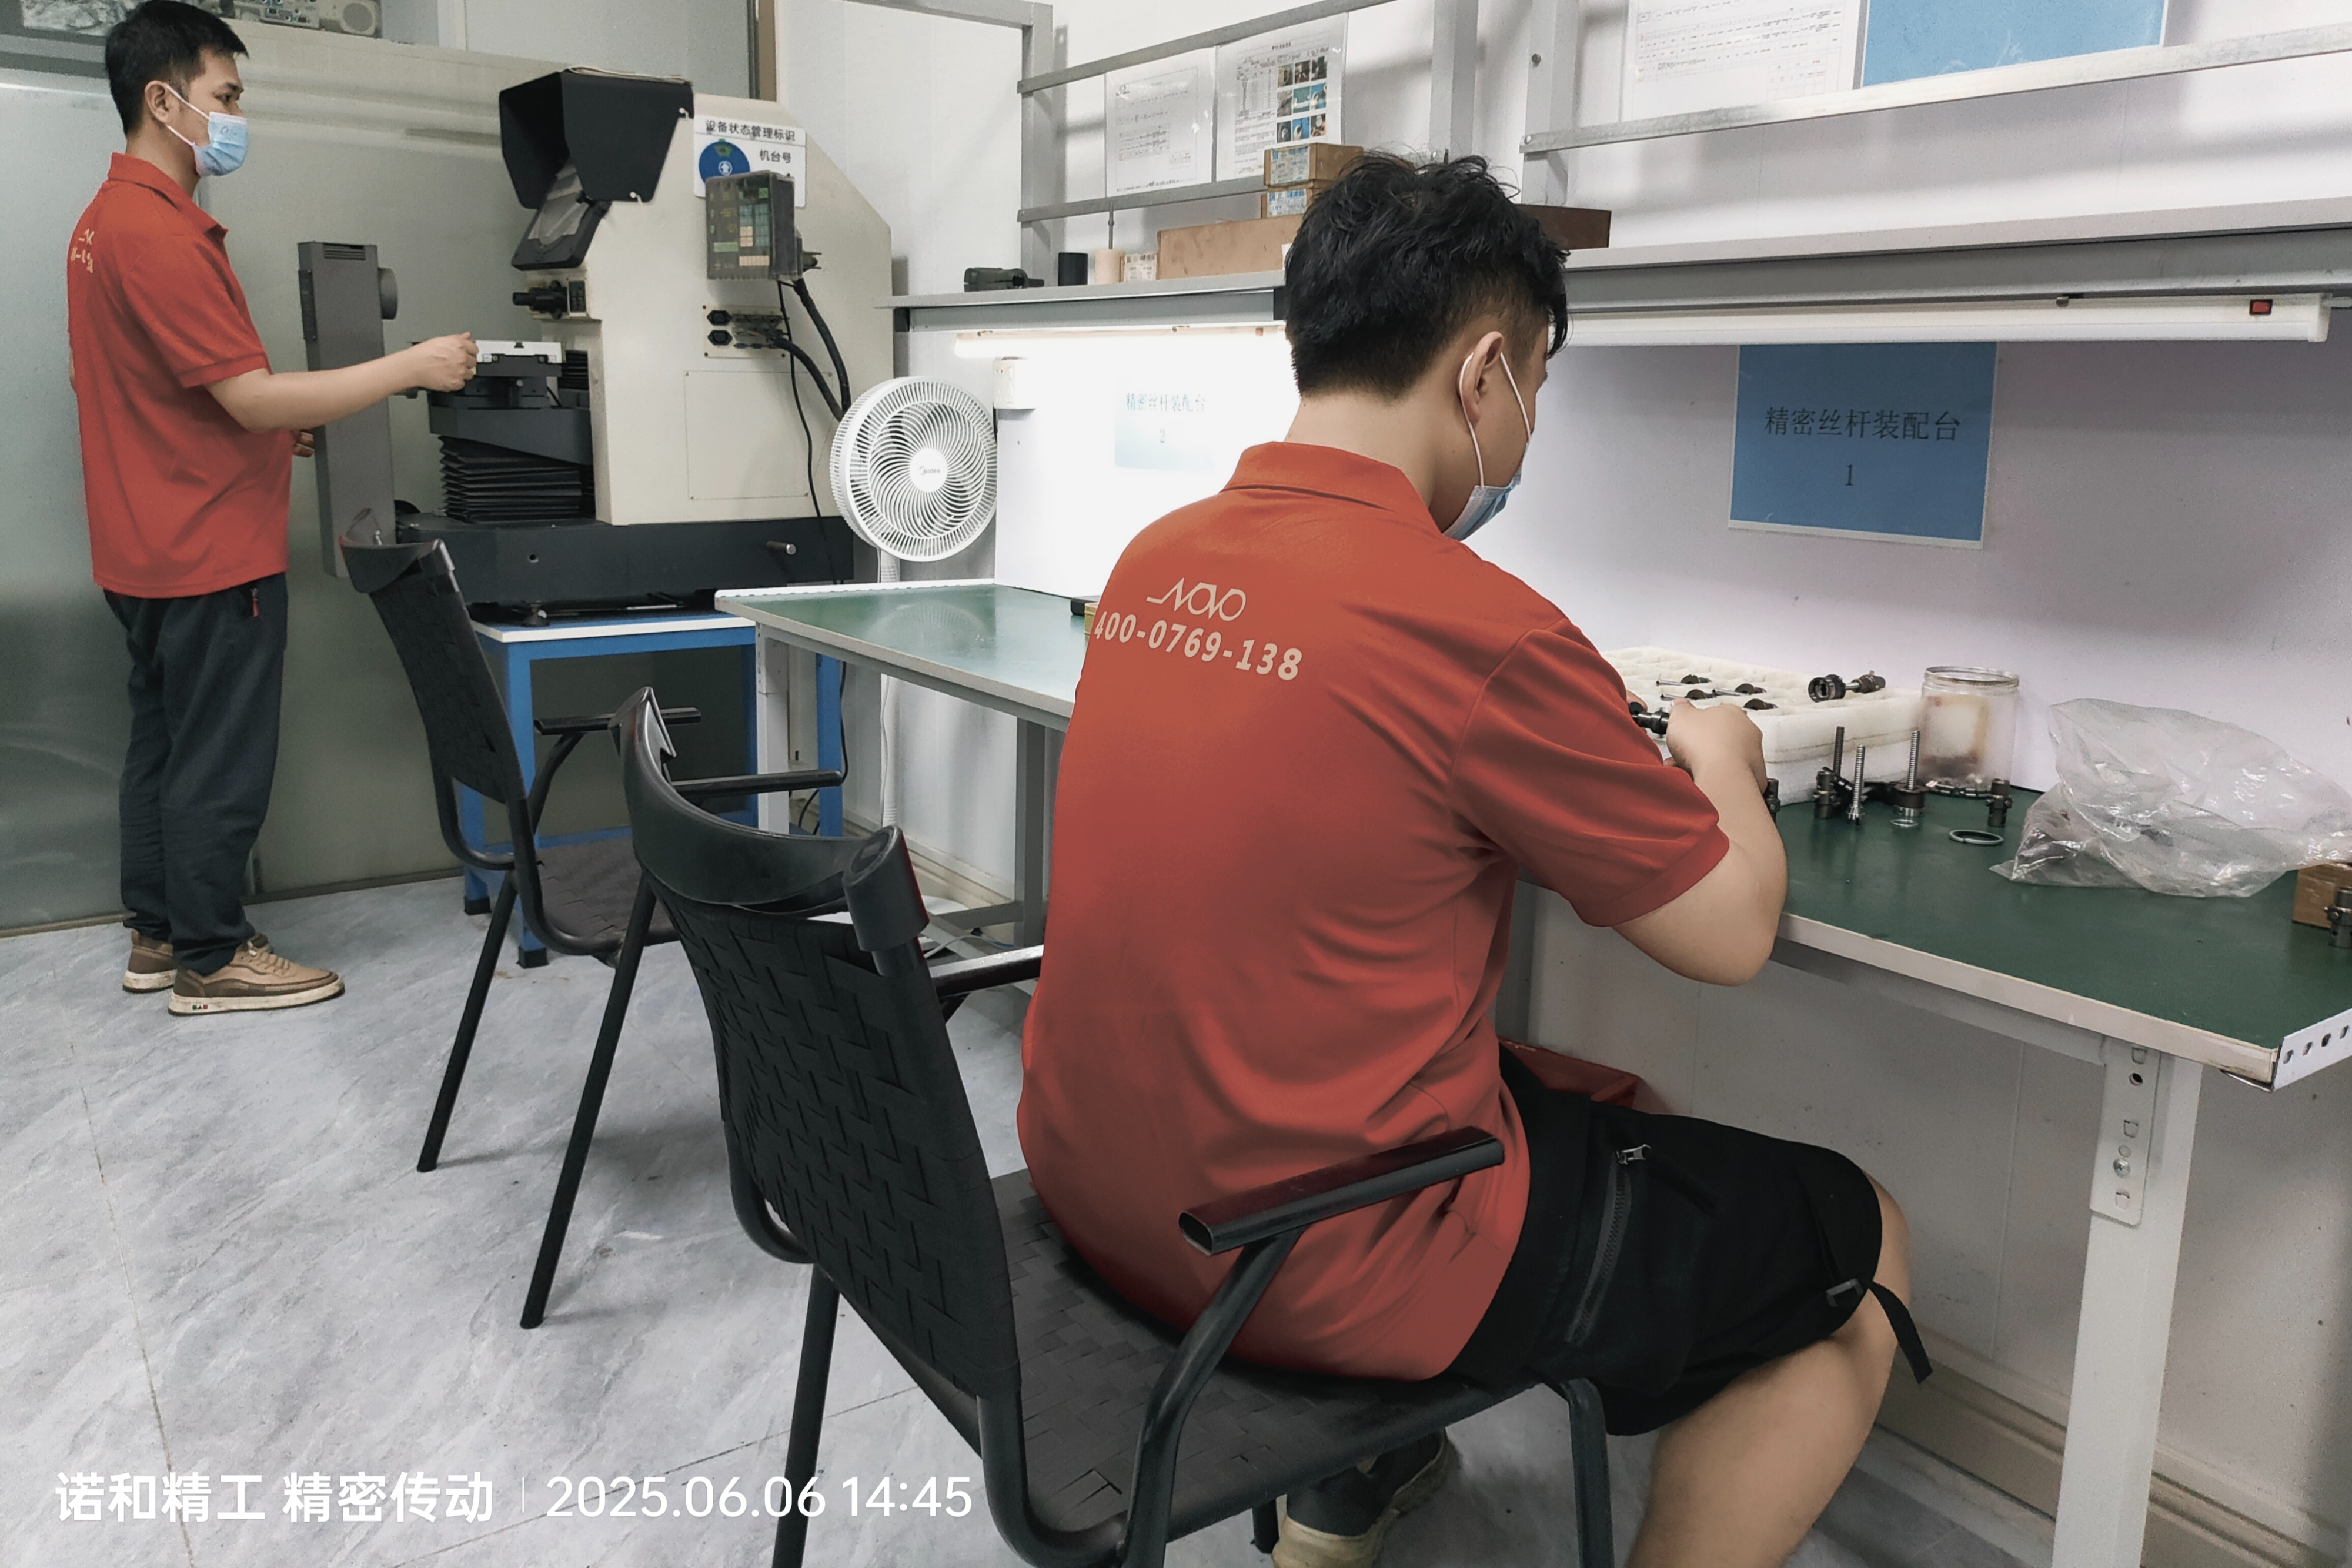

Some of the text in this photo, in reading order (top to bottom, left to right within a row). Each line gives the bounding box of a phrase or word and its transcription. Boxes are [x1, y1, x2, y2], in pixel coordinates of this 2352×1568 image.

[706, 120, 796, 141] 设备状态管理标识
[759, 149, 792, 163] 机台号
[1127, 392, 1205, 412] 精密丝杆装配台
[1765, 406, 1960, 441] 精密丝杆装配台
[1160, 429, 1165, 443] 2
[1845, 464, 1854, 486] 1
[1094, 611, 1302, 681] 400-0769-138
